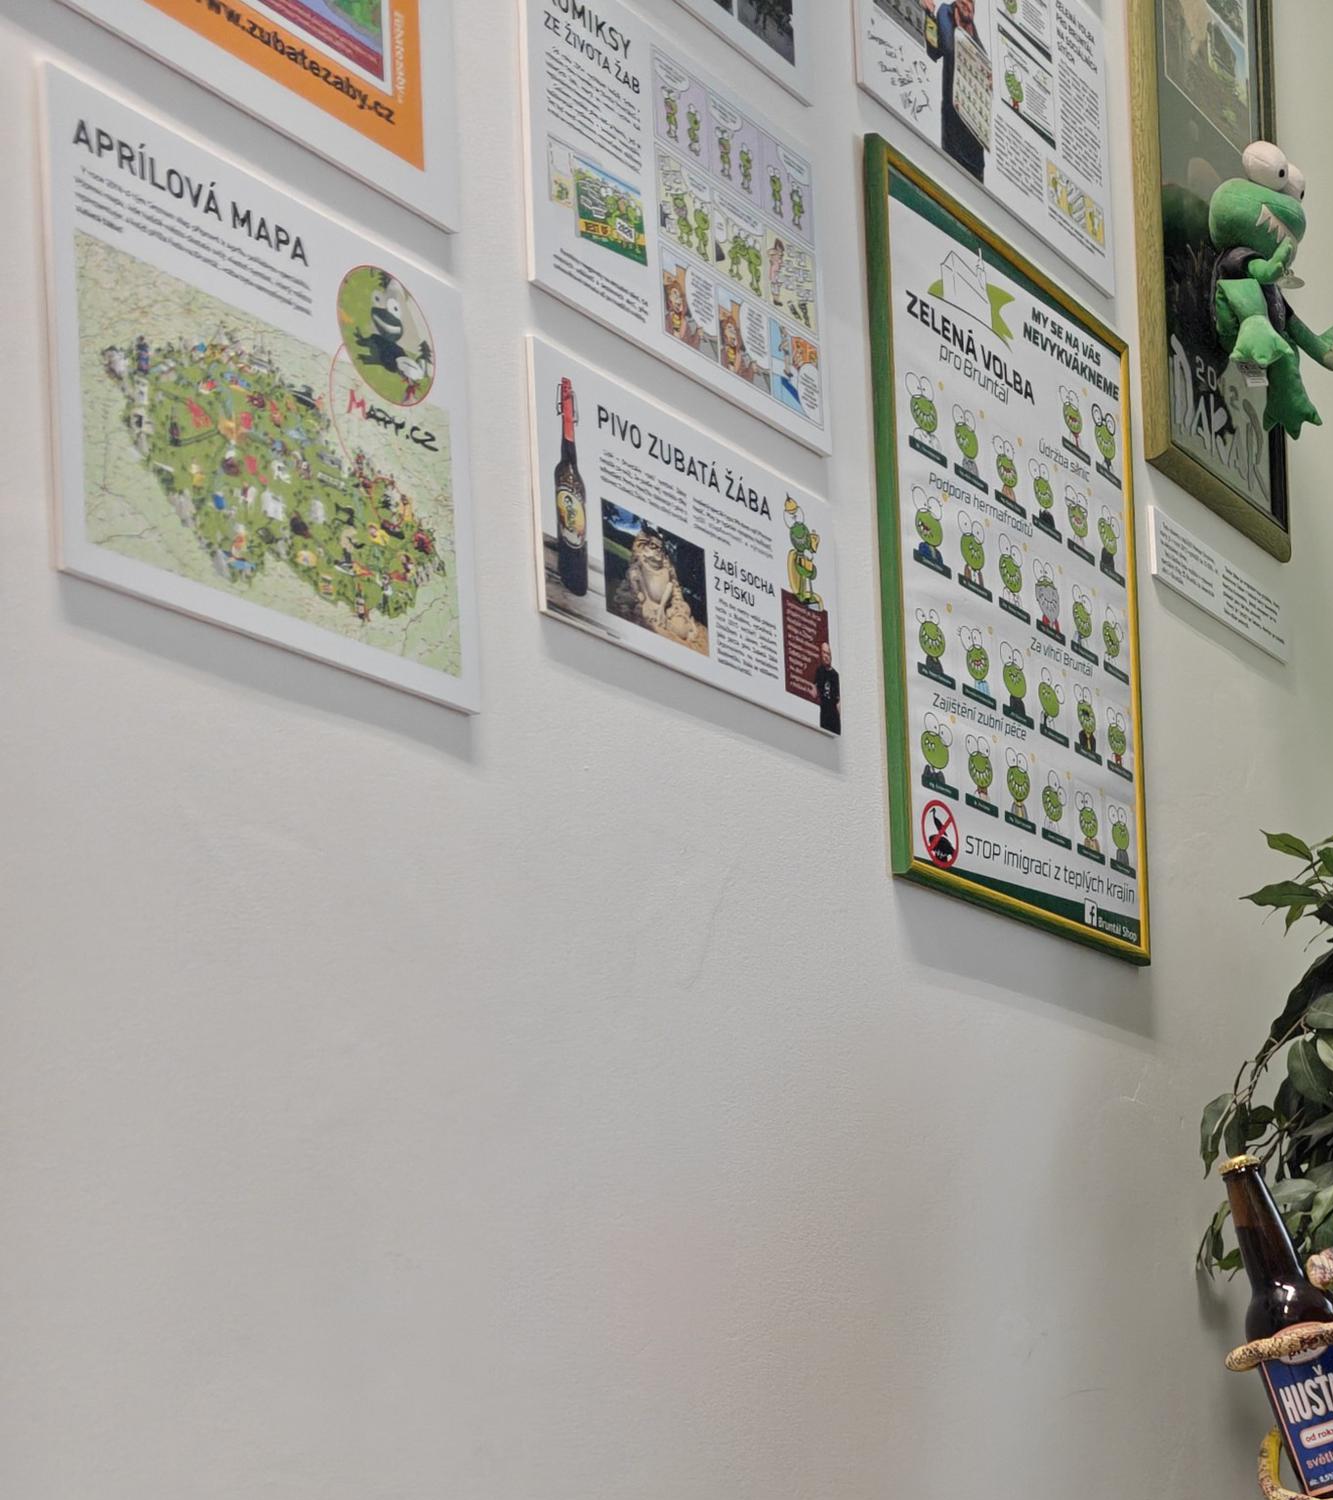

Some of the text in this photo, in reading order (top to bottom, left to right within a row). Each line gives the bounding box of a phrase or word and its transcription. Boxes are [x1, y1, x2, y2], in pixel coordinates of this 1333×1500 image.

[544, 10, 640, 94] ZE ŽIVOTA ŽAB
[552, 0, 631, 60] OMIKSY
[72, 119, 223, 222] APRÍLOVÁ
[232, 201, 309, 267] MAPA
[905, 289, 1036, 406] ZELENÁ VOLBA
[1023, 321, 1120, 402] NEVYKVÁKNEME
[1032, 306, 1101, 367] MY SE NA VÁS
[939, 344, 1009, 406] pro Bruntál
[597, 404, 642, 449] PIVO
[648, 432, 721, 493] ZUBATÁ
[725, 468, 772, 522] ŽÁBA
[1038, 437, 1070, 470] Údržba
[928, 472, 971, 505] Podpora
[973, 494, 1034, 538] hermafroditů
[713, 551, 776, 597] ŽABÍ SOCHA
[714, 576, 755, 608] Z PÍSKU
[1030, 636, 1043, 653] Za
[1064, 652, 1093, 678] Bruntál
[932, 692, 977, 720] Zajištění
[977, 710, 1005, 732] zubní
[1004, 720, 1027, 742] péče
[965, 835, 1001, 861] STOP
[1004, 845, 1051, 878] imigraci
[1054, 865, 1061, 881] z
[1064, 867, 1104, 894] teplých
[1106, 878, 1136, 904] krajin
[1097, 916, 1121, 936] Bruntál
[1122, 925, 1137, 943] Shop
[1305, 1432, 1316, 1443] od
